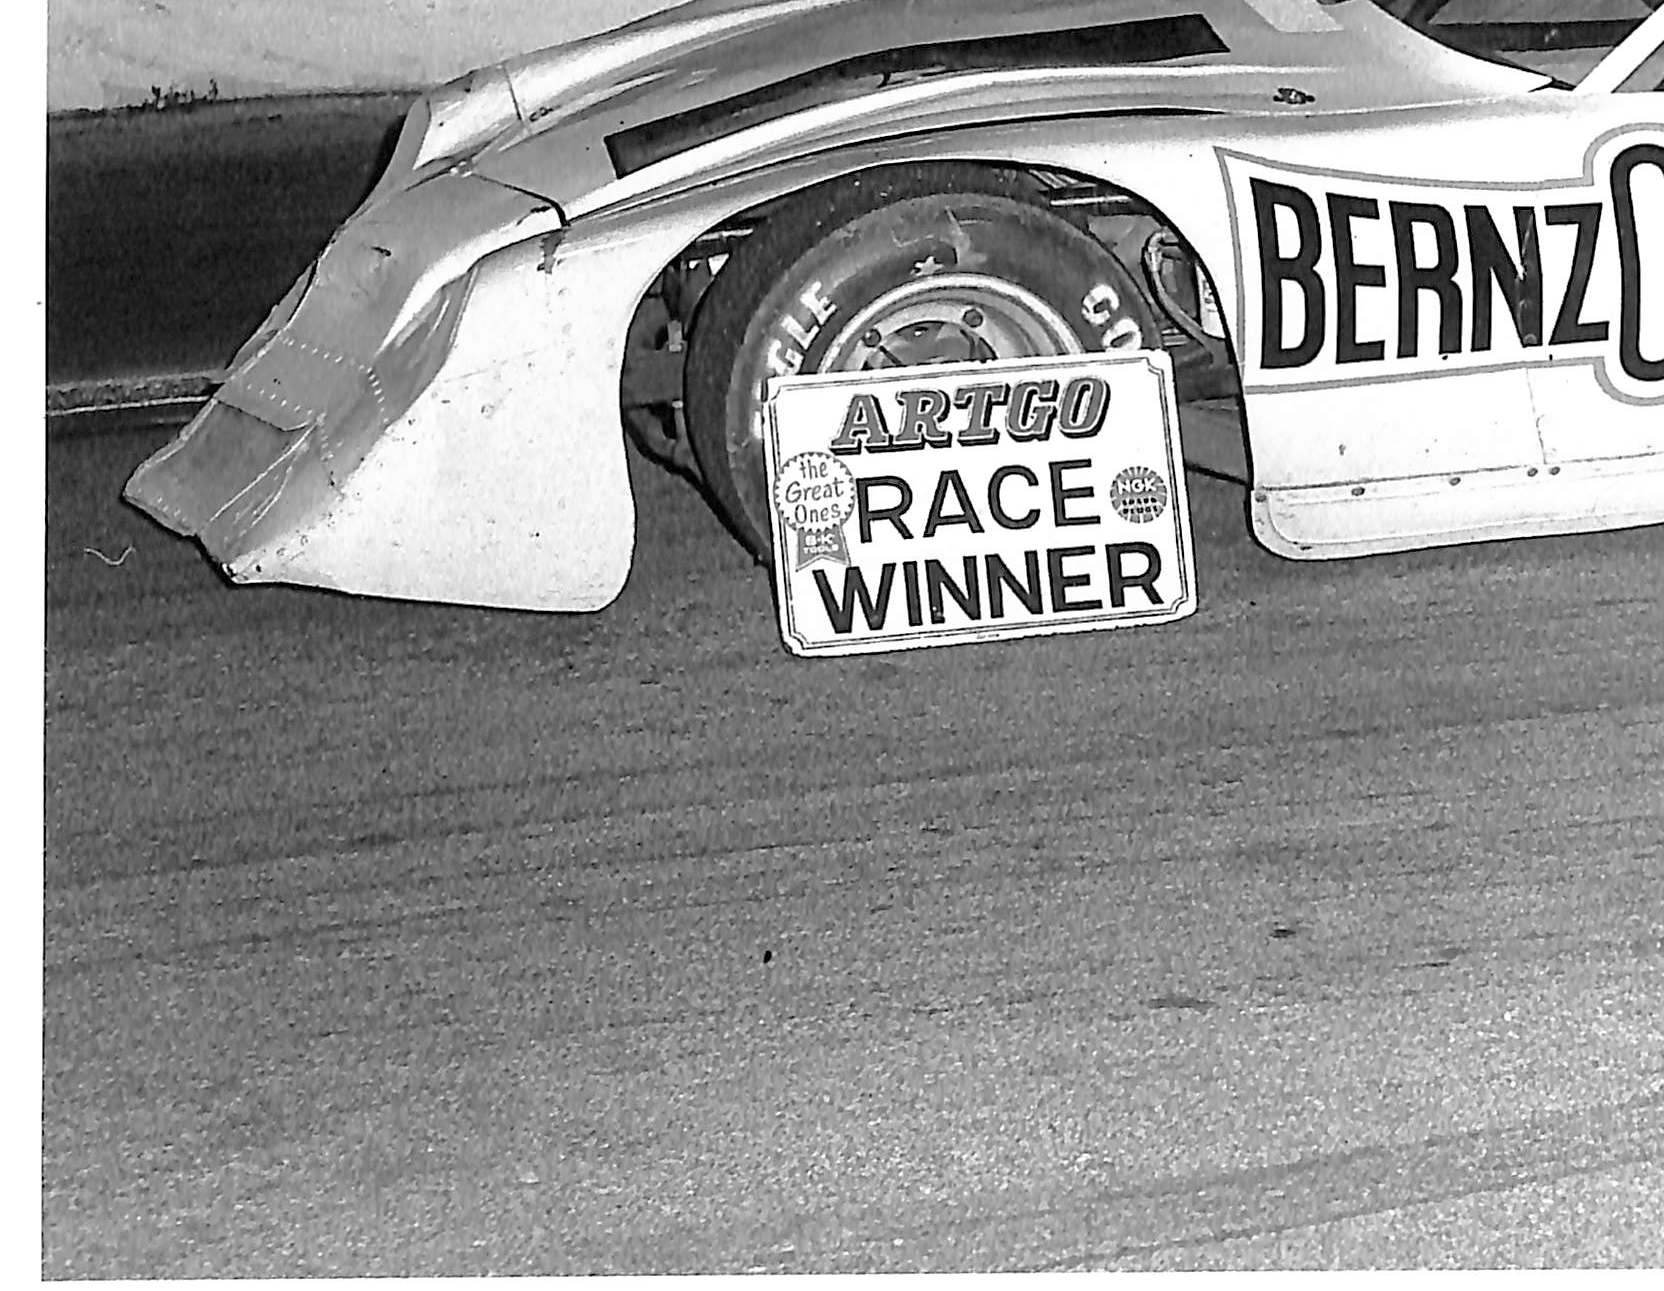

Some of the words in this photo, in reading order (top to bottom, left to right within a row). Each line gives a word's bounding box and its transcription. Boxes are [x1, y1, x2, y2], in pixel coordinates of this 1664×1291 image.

[830, 377, 1110, 455] ARTGO
[799, 459, 829, 479] the
[785, 477, 844, 503] Great
[1117, 477, 1157, 495] NGK
[855, 458, 1101, 543] RACE
[795, 504, 841, 524] Ones
[812, 542, 1165, 635] WINNER
